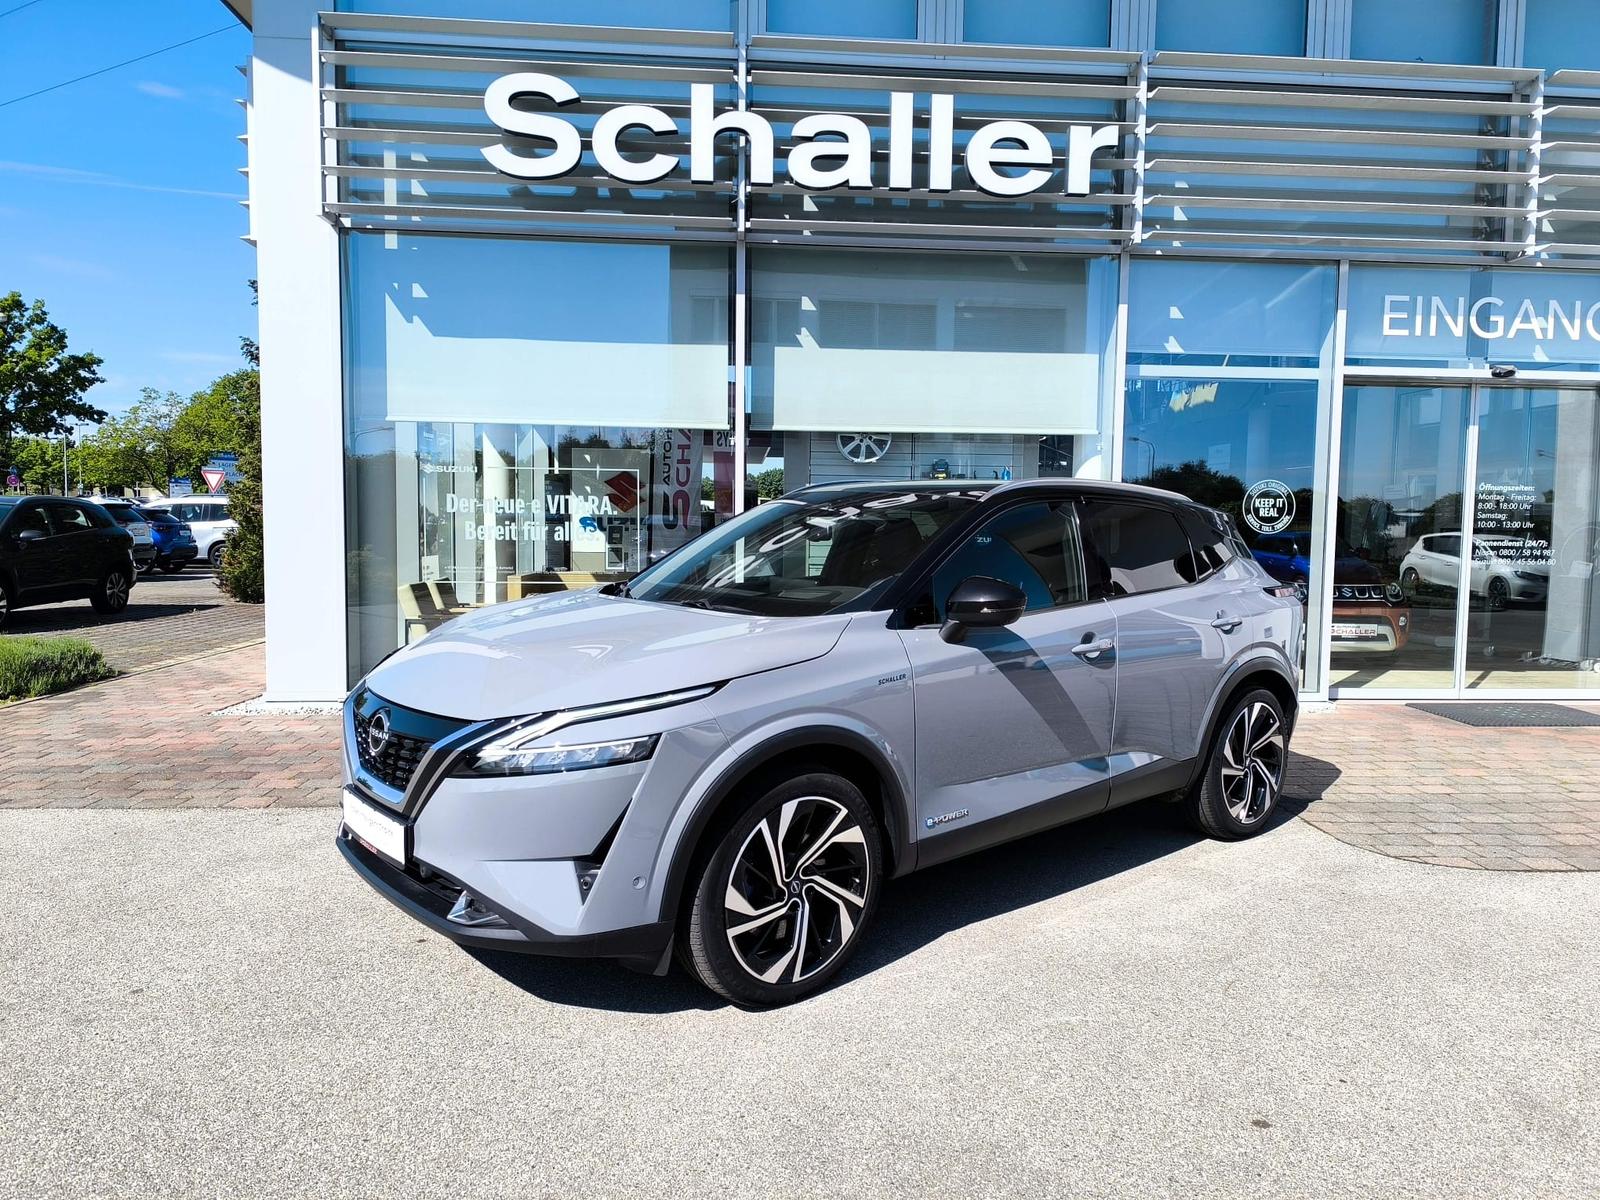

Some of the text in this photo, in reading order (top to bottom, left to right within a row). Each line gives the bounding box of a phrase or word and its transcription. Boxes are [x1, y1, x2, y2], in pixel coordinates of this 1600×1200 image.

[480, 72, 1120, 197] Schaller
[437, 465, 478, 473] SUZUKI
[1479, 482, 1535, 492] Öffnungszeiten:
[1255, 498, 1283, 507] KEEP IT
[1478, 494, 1505, 502] Montag
[1511, 494, 1537, 503] Freitag:
[446, 493, 618, 515] Der neue e VITARA.
[1259, 508, 1279, 517] REAL
[1477, 512, 1508, 520] Samstag:
[1522, 521, 1535, 529] Uhr
[464, 520, 518, 541] Bereit
[522, 520, 548, 541] für
[1525, 540, 1548, 548] (24/7):
[878, 673, 907, 686] SCHALLER
